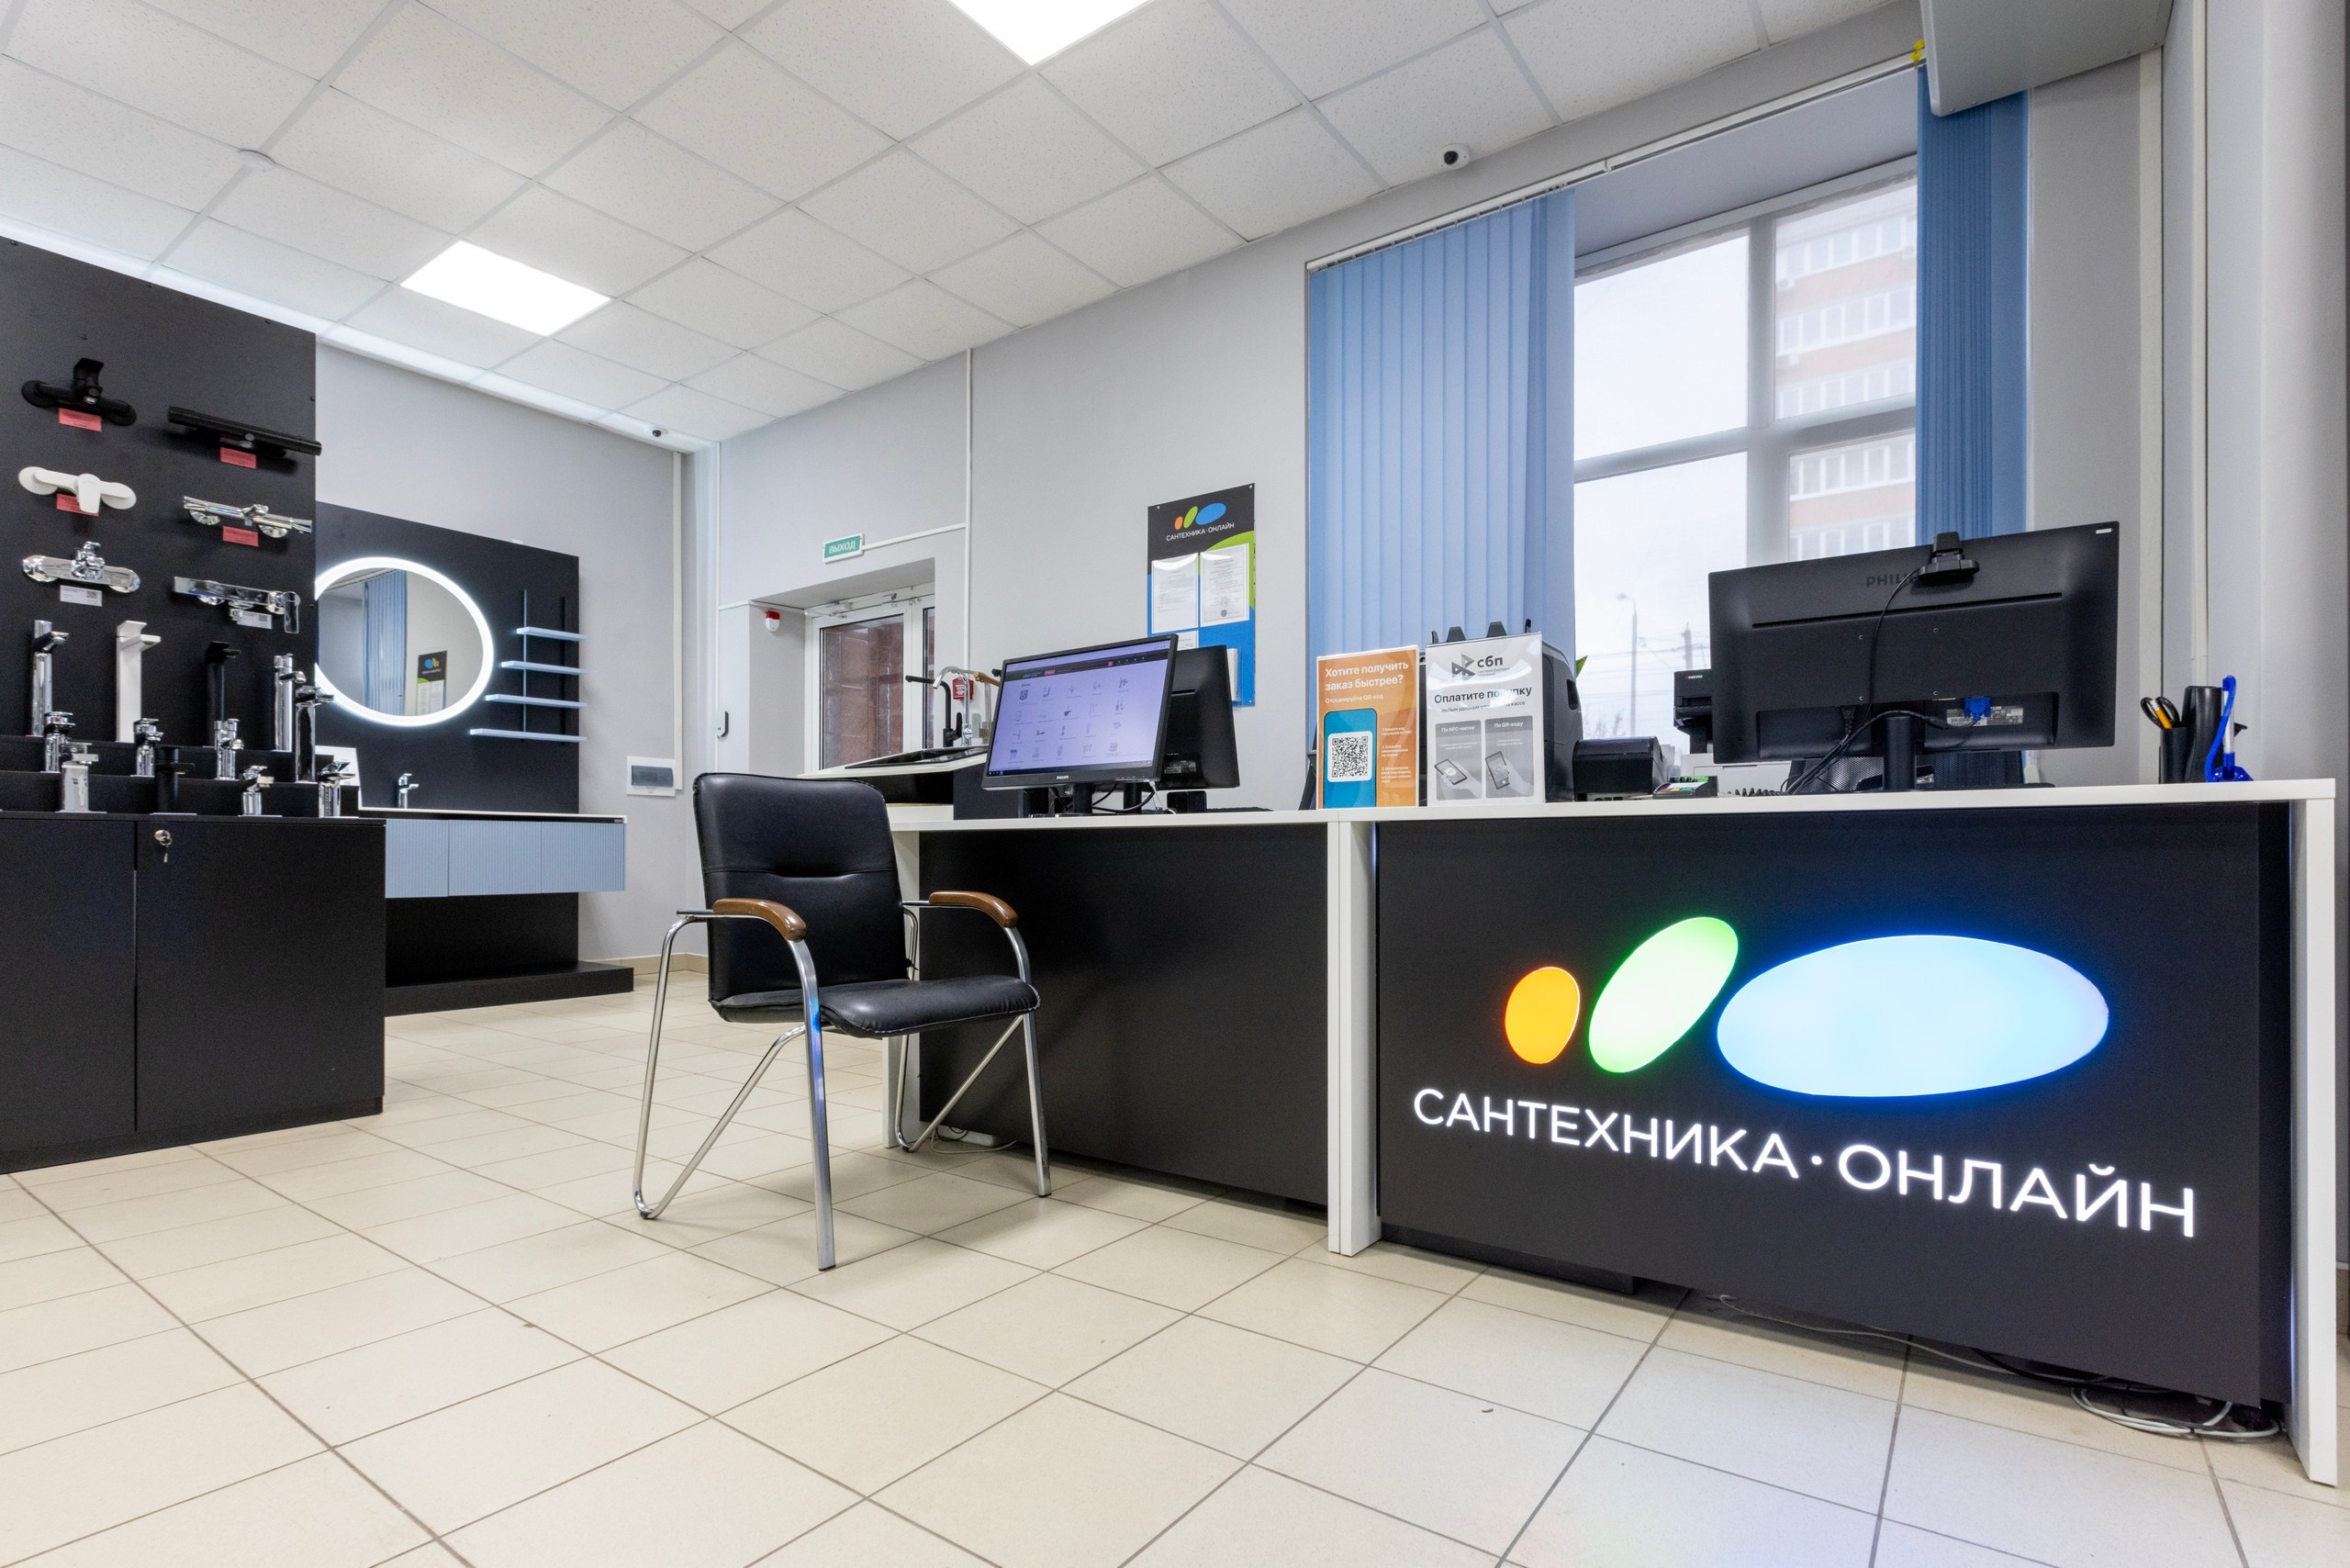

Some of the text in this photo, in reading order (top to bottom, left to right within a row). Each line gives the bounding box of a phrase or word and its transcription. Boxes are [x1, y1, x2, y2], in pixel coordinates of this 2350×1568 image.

[829, 541, 856, 554] ВЫХОД
[1477, 655, 1504, 668] сбп
[1325, 660, 1409, 678] Хотите получить
[1325, 675, 1404, 691] заказ быстрее?
[1434, 691, 1485, 704] Оплатите
[1414, 1089, 2196, 1238] САНТЕХНИКА ОНЛАЙН
